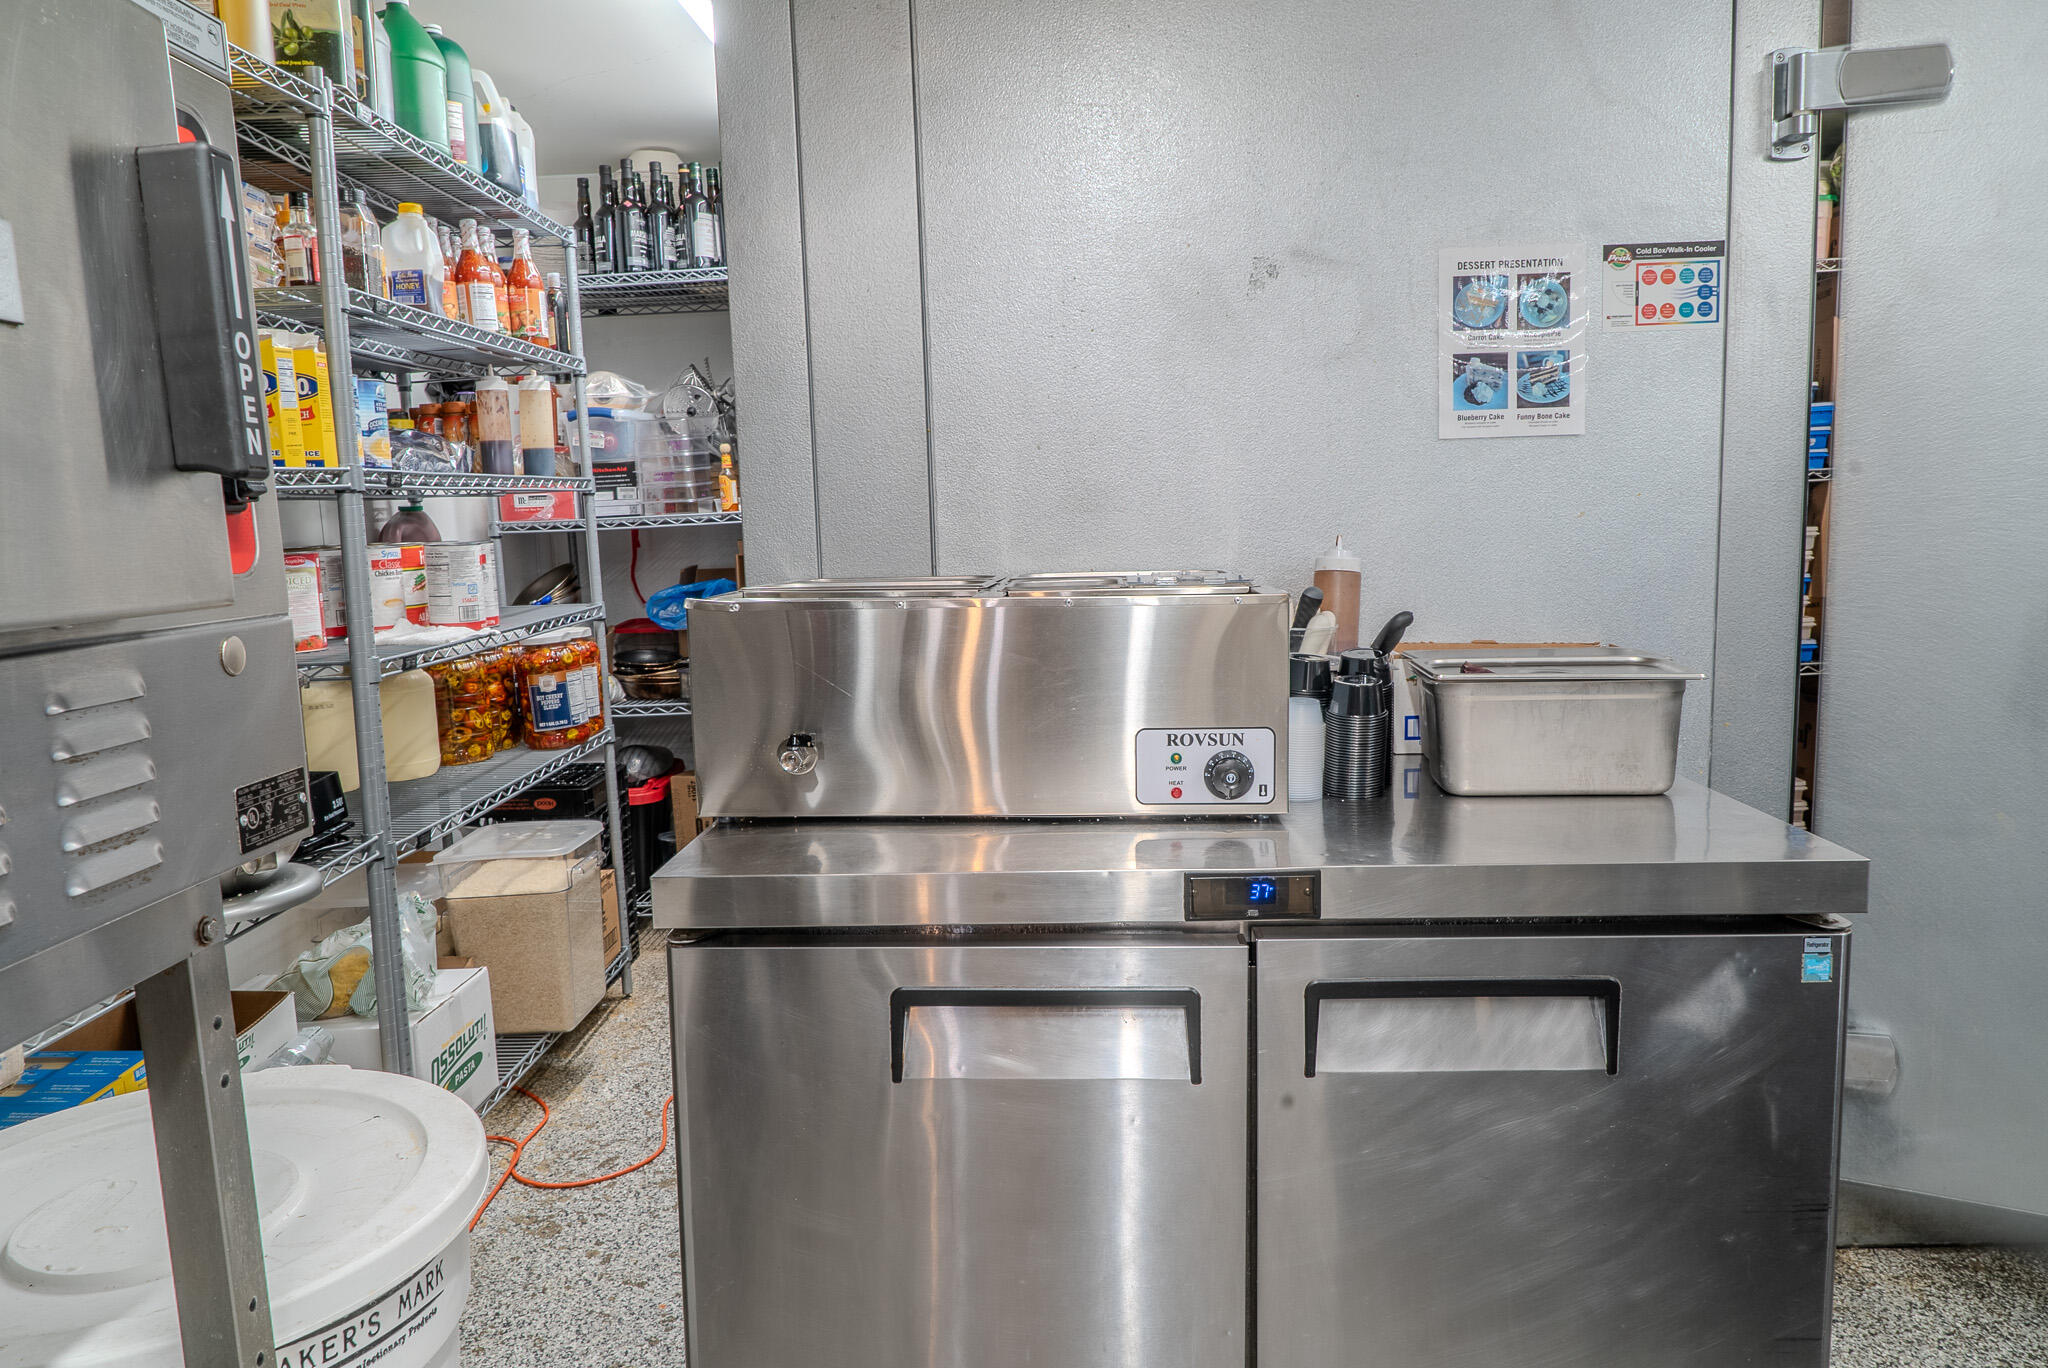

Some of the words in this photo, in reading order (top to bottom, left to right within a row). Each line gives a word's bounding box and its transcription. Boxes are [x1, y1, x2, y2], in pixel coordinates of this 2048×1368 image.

[1653, 246, 1693, 254] Box/Walk-In
[1694, 245, 1717, 253] Cooler
[1457, 260, 1496, 271] DESSERT
[1498, 257, 1564, 269] PRESENTATION
[396, 282, 420, 291] HONEY
[234, 331, 263, 456] OPEN
[1457, 413, 1488, 422] Blueberry
[1488, 413, 1505, 421] Cake
[1517, 413, 1535, 422] Funny
[1537, 412, 1553, 420] Bone
[1554, 412, 1571, 420] Cake
[287, 576, 312, 585] ICED
[1166, 732, 1245, 747] ROVSUN
[454, 1059, 476, 1086] PASTA
[397, 1258, 444, 1319] MARK
[407, 1306, 438, 1338] Products
